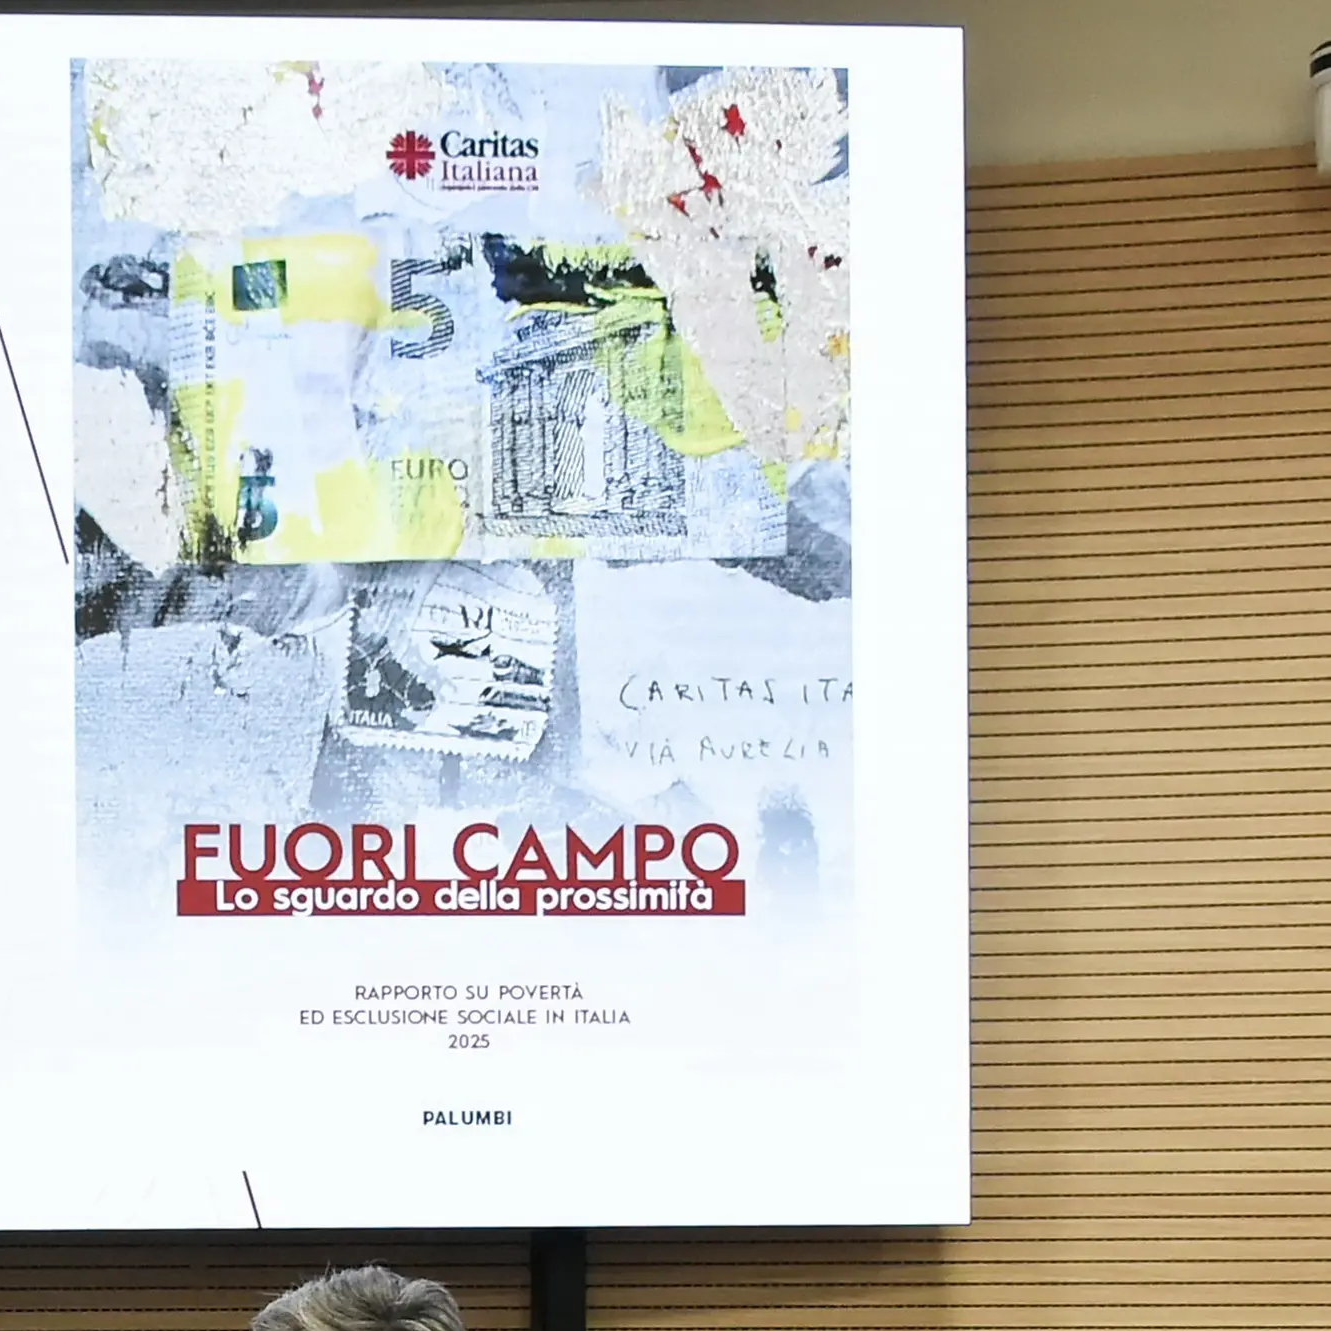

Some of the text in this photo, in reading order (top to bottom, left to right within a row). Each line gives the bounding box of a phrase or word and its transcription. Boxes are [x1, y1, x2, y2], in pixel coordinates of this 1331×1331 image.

[440, 130, 539, 158] Caritas
[440, 160, 538, 182] Italiana
[389, 258, 455, 359] 5
[619, 674, 776, 712] CARITAS
[184, 822, 740, 881] FUORI CAMPO
[216, 879, 714, 916] Lo sguardo della prossimità
[354, 982, 584, 1000] RAPPORTO SU POVERTÀ
[299, 1009, 632, 1025] ED ESCLUSIONE SOCIALE IN ITALIA
[448, 1033, 491, 1049] 2025
[422, 1110, 513, 1125] PALUMBI
